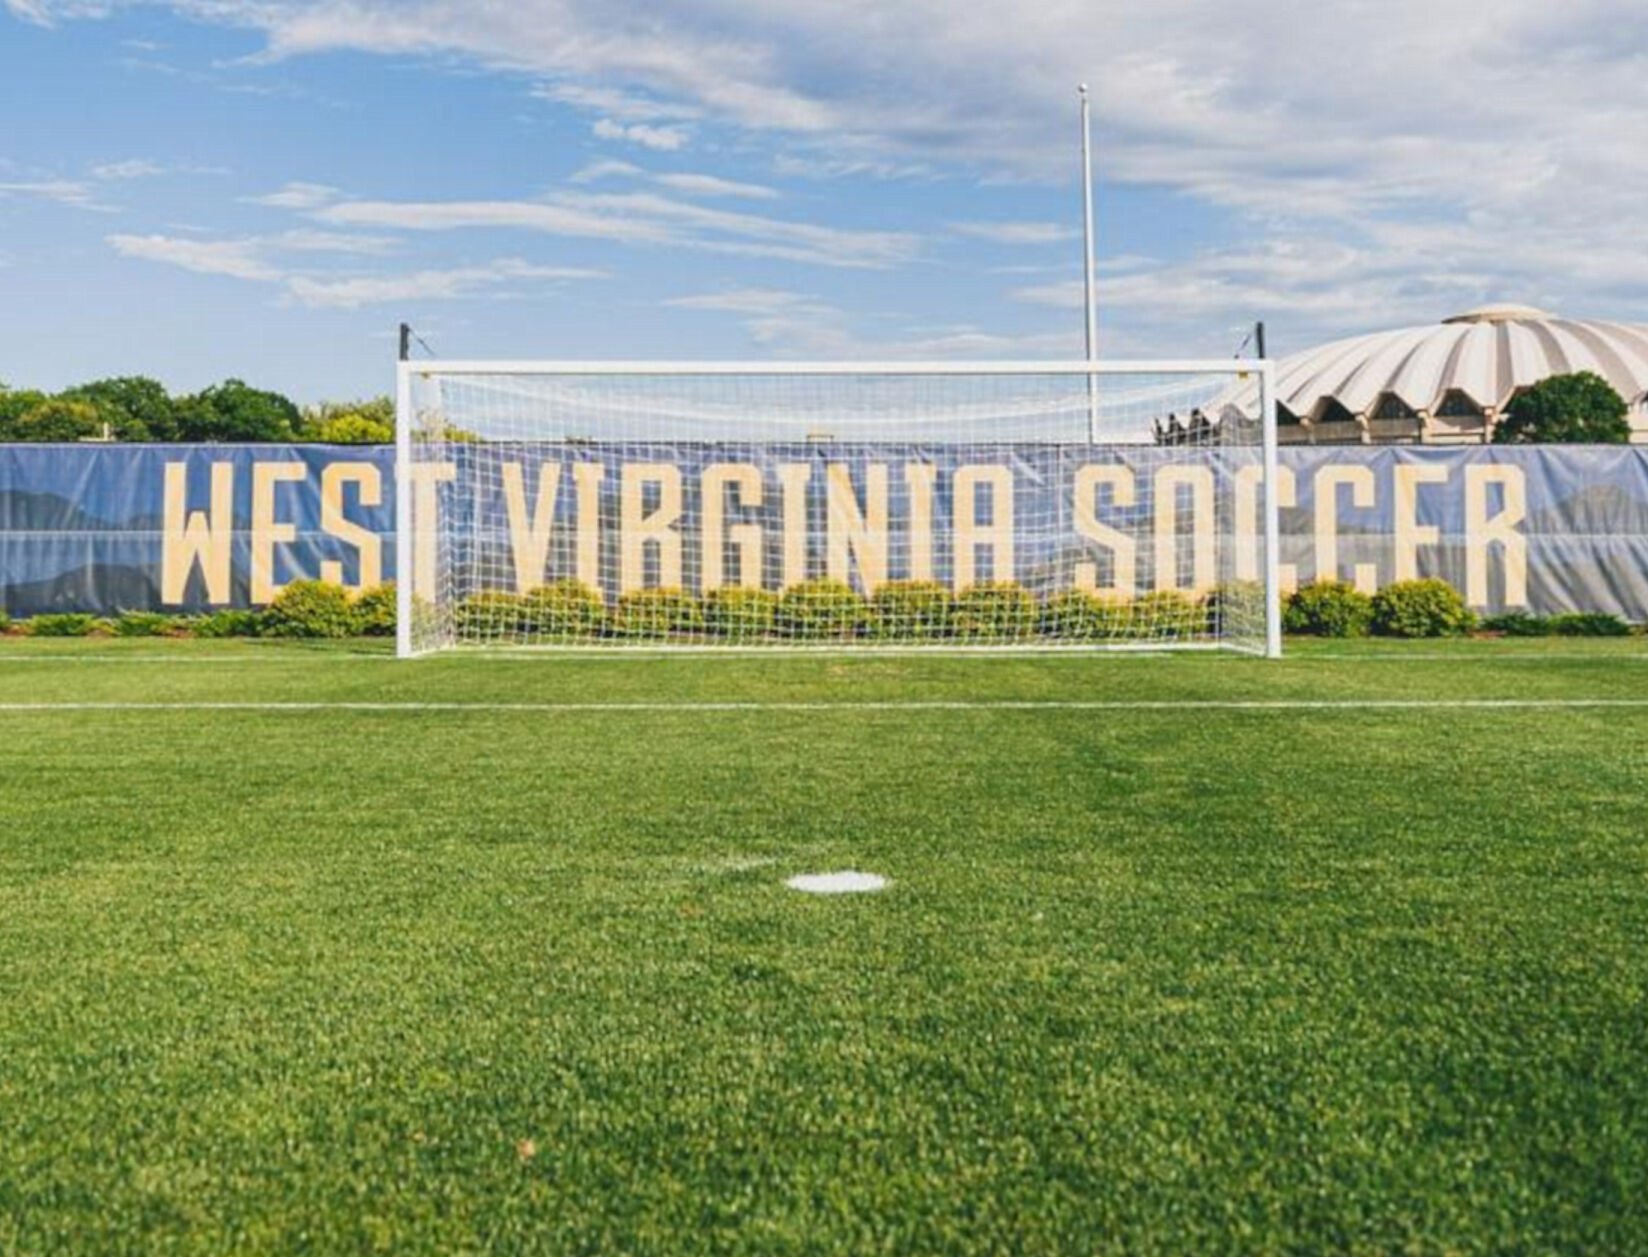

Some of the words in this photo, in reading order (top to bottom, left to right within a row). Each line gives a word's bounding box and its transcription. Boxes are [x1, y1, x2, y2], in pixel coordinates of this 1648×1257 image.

[161, 461, 457, 605] WEST
[501, 462, 1015, 602] VIRGINIA
[1073, 463, 1528, 607] SOCCER
